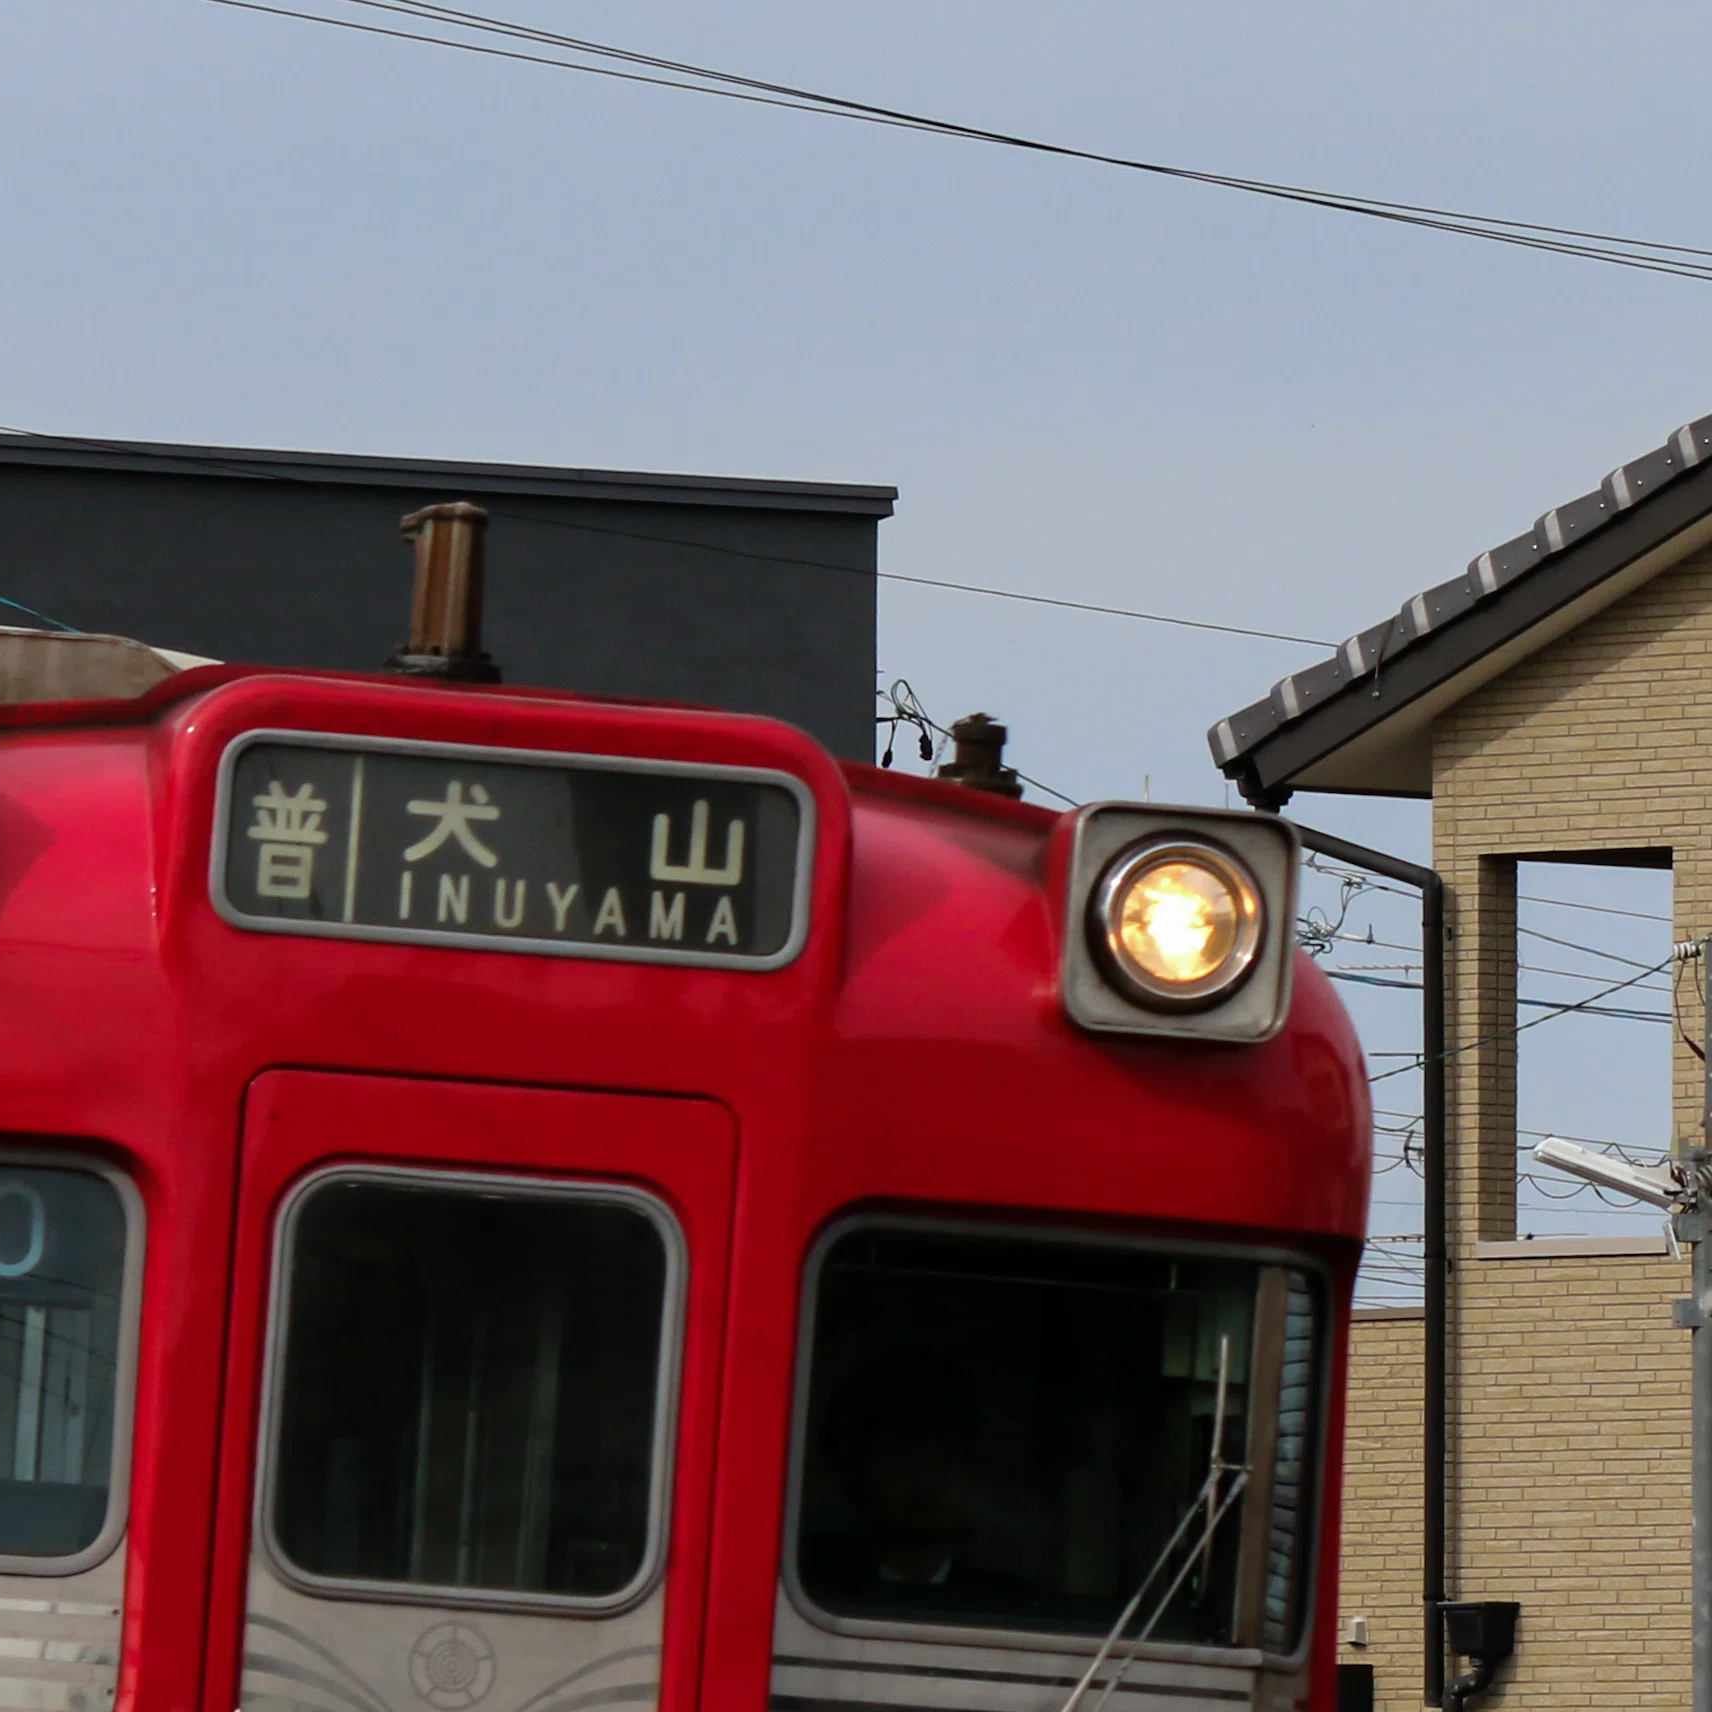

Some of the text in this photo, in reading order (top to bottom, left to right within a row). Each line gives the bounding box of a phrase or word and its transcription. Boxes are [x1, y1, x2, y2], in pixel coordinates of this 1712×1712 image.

[247, 779, 329, 900] 普
[405, 779, 746, 887] 犬山
[397, 870, 740, 946] INUYAMA
